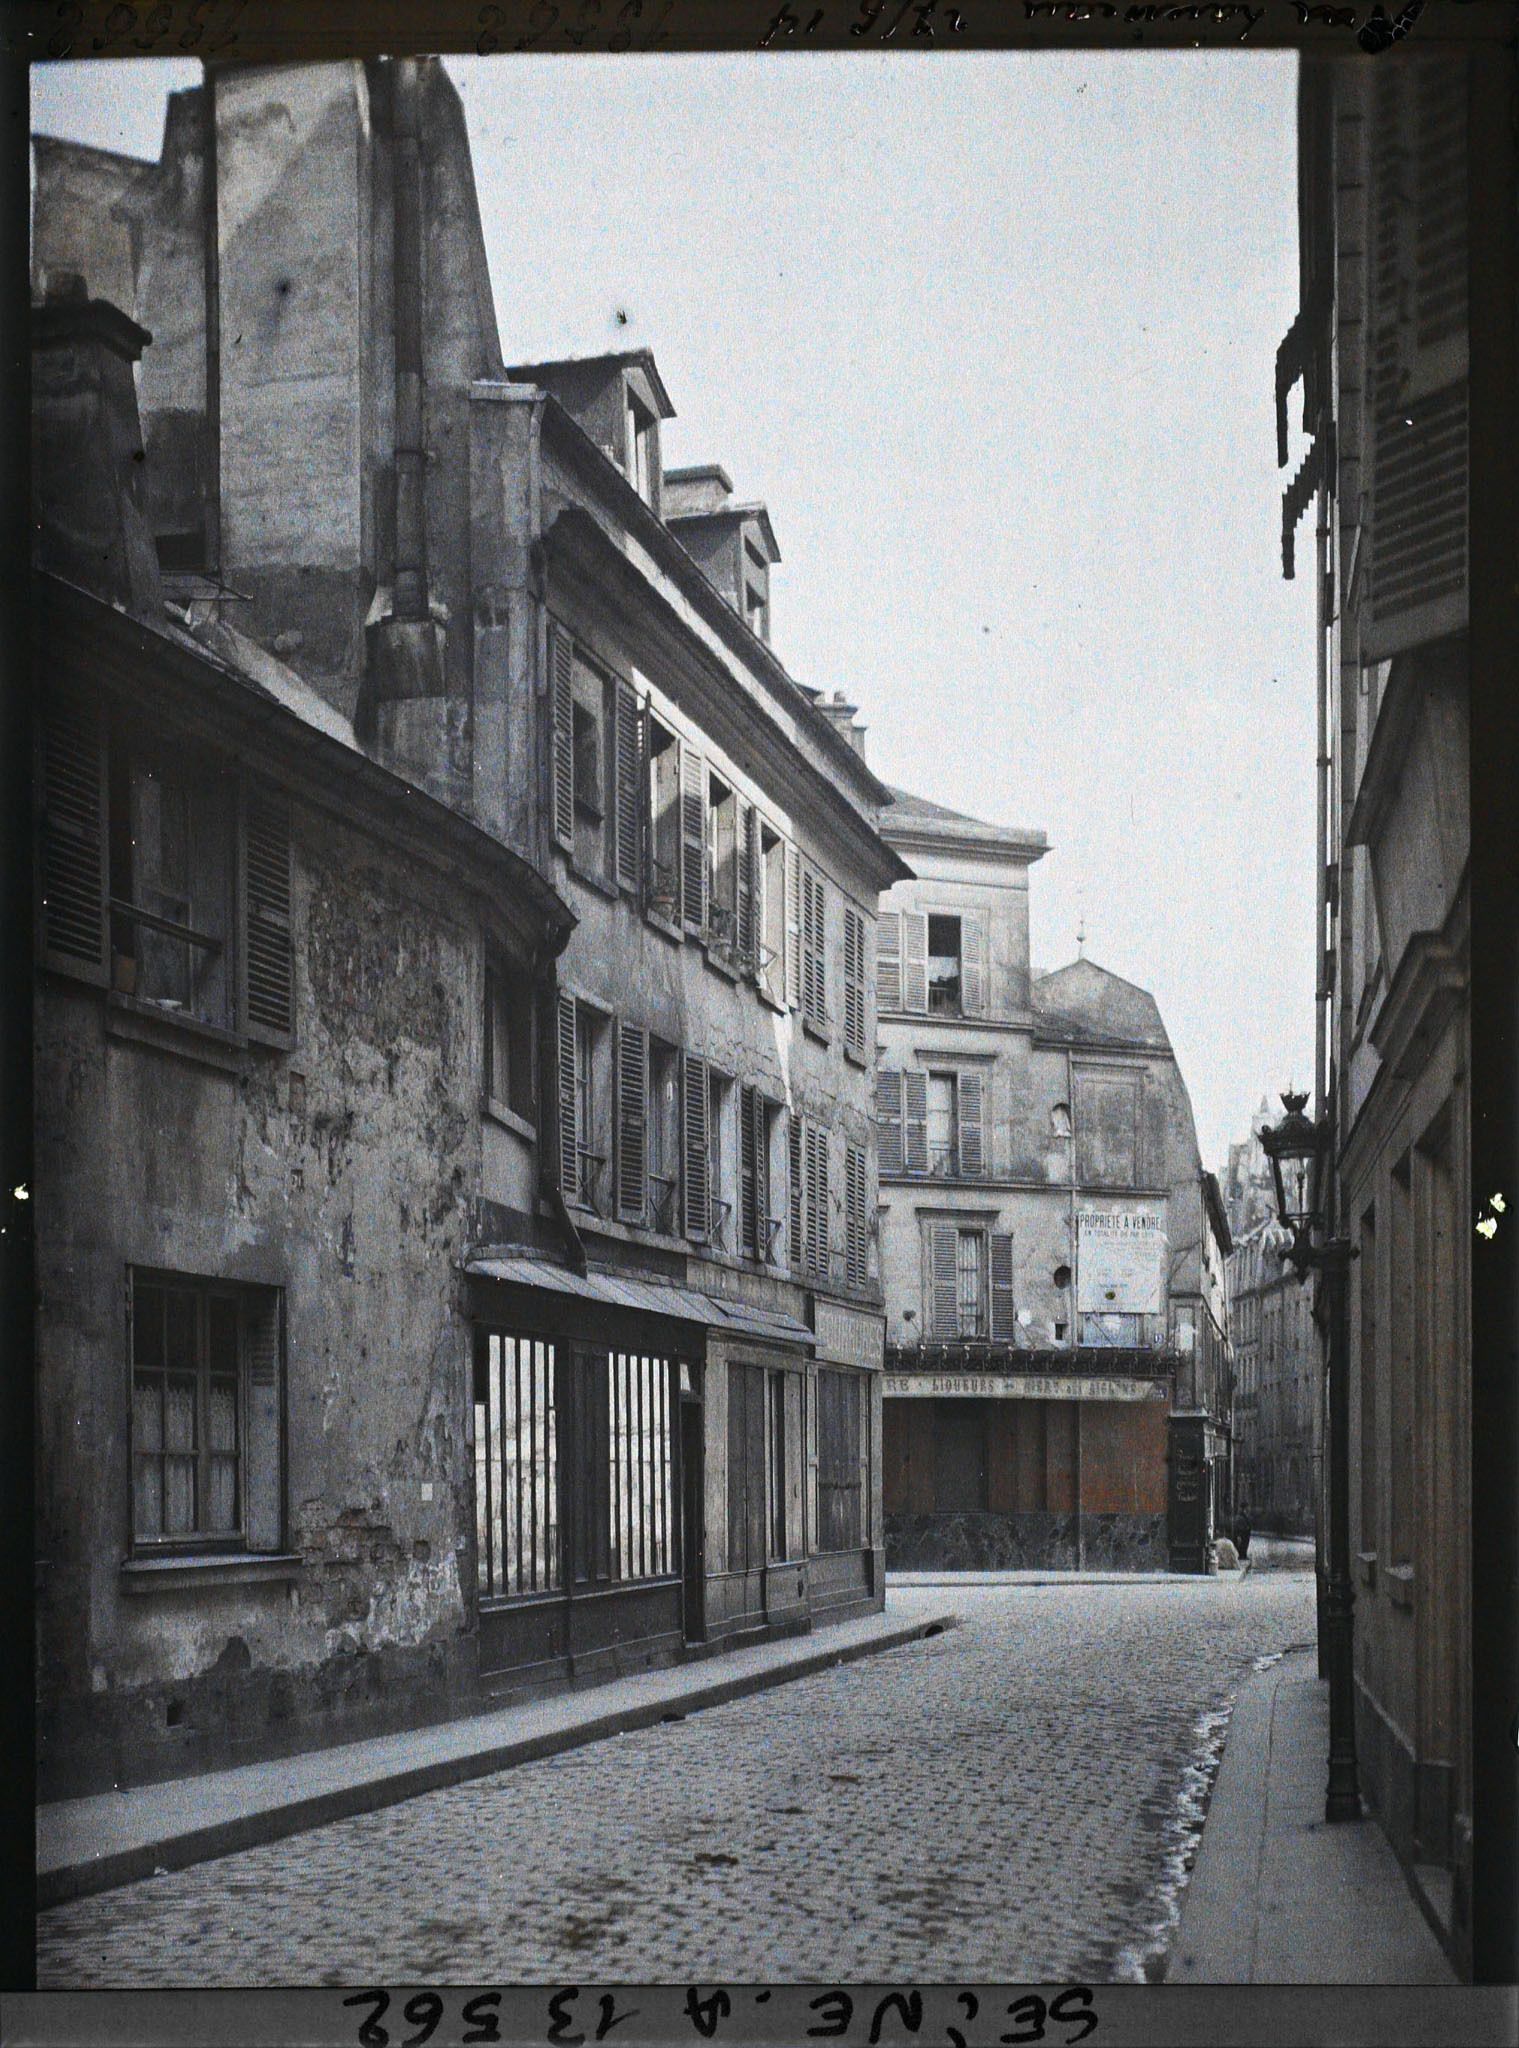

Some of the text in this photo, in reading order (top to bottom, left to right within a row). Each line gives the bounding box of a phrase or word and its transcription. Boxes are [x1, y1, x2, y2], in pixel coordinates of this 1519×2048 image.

[1132, 1216, 1160, 1230] VENDRE
[818, 1309, 883, 1361] FOURRURES
[931, 1376, 994, 1392] LIQUEURS
[341, 1987, 503, 2047] 562
